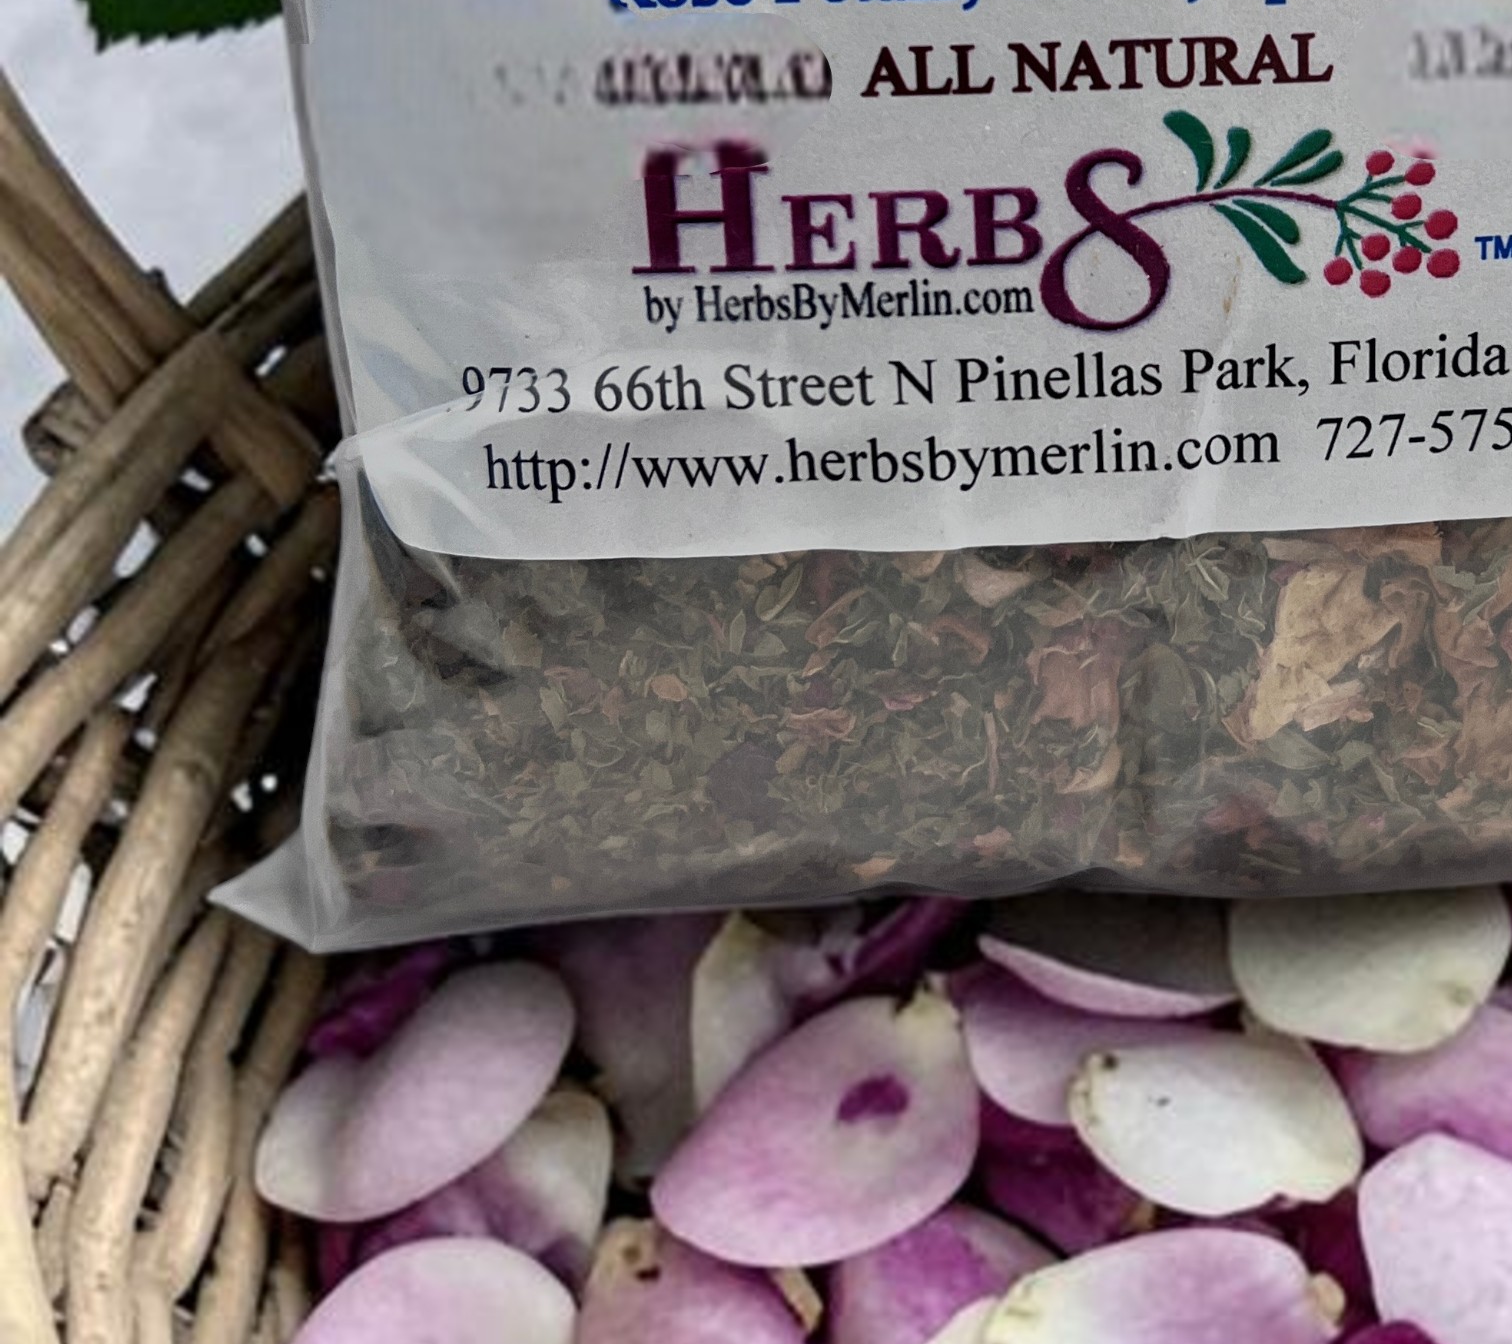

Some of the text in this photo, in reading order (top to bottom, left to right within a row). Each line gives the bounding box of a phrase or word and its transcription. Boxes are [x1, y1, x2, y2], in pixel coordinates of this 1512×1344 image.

[861, 44, 995, 98] ALL
[1010, 32, 1335, 94] NATURAL
[644, 278, 1035, 332] by HerbsByMerlin.com
[462, 364, 572, 413] 9733
[593, 364, 706, 412] 66th
[723, 362, 874, 409] Street
[889, 358, 936, 406] N
[956, 351, 1163, 404] Pinellas
[1180, 343, 1311, 397] Park,
[1329, 331, 1510, 387] Florida
[485, 428, 1280, 504] http://www.herbsbymerlin.com
